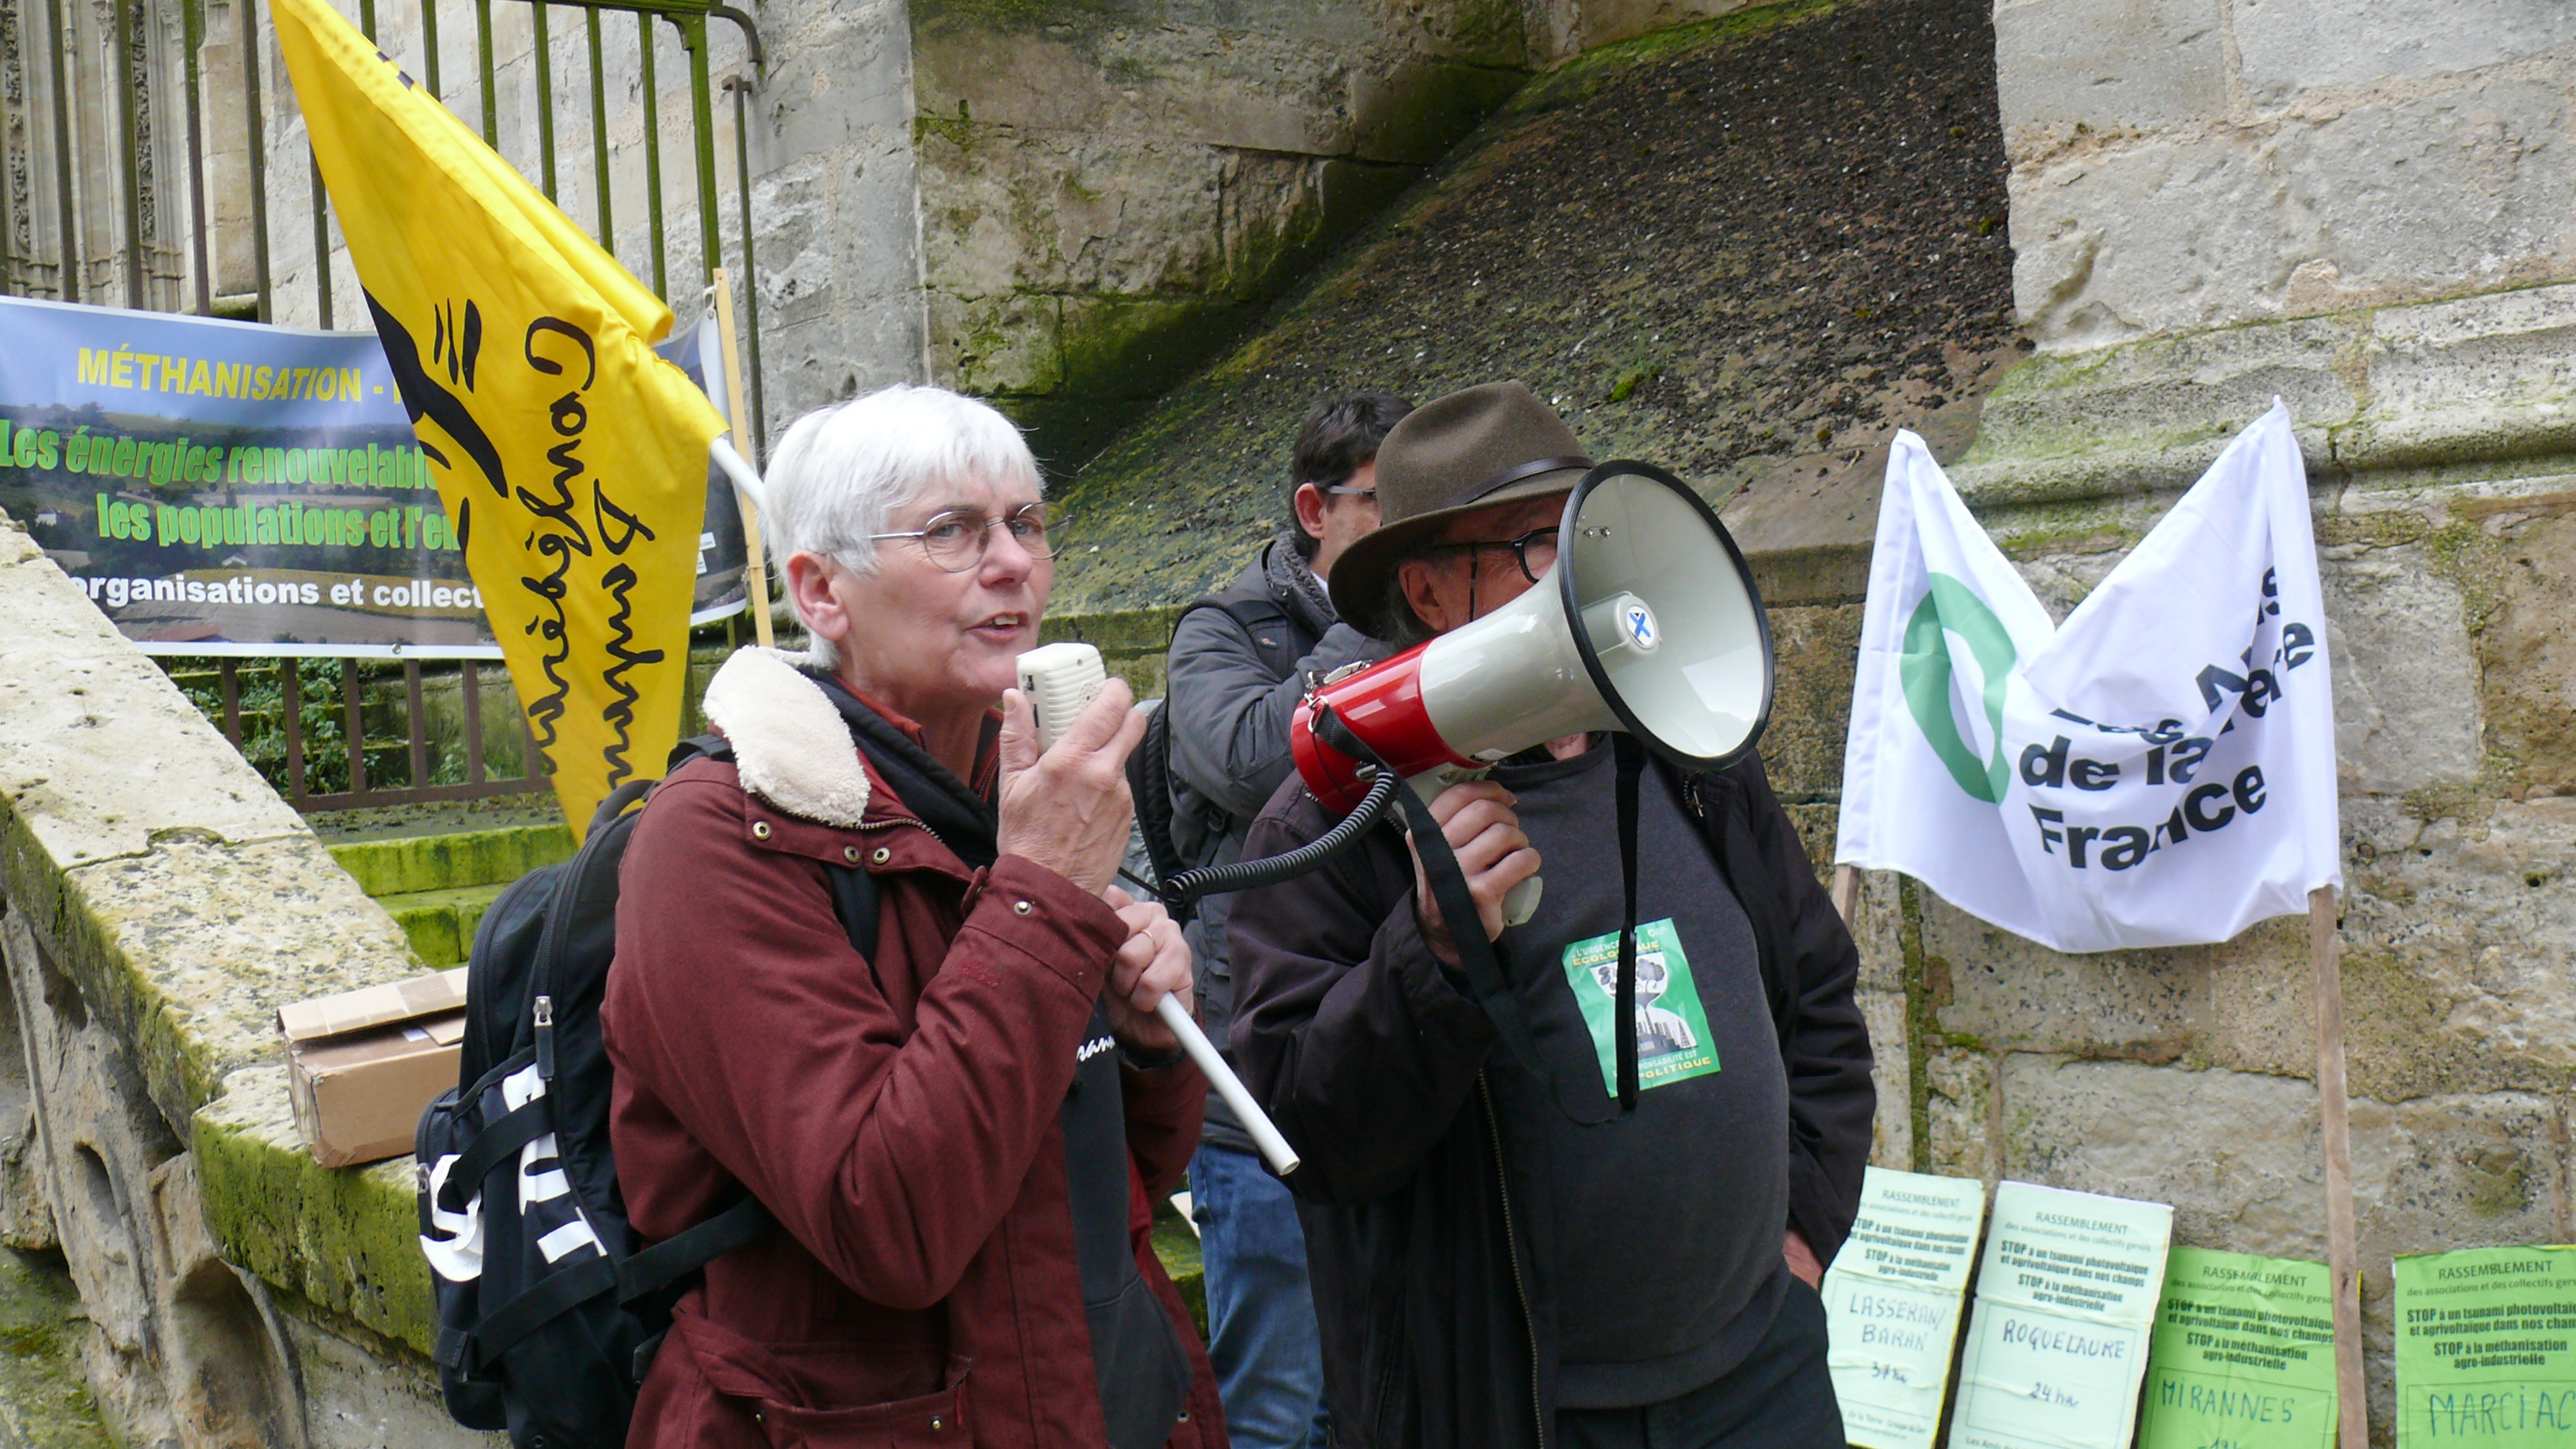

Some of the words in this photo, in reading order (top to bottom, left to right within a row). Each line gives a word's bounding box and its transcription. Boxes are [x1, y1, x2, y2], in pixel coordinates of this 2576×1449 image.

[77, 343, 361, 402] MÉTHANISATION
[0, 419, 59, 470] Les
[65, 425, 224, 486] énergies
[97, 492, 152, 541] les
[156, 501, 364, 549] populations
[370, 507, 400, 551] et
[331, 576, 364, 608] et
[2019, 735, 2120, 791] de
[2028, 765, 2267, 871] France
[1882, 1190, 1961, 1208] RASSEMBLEMENT
[2020, 1224, 2067, 1240] associations
[2036, 1211, 2128, 1235] RASSEMBLEMENT
[1864, 1248, 1888, 1261] STOP
[2001, 1239, 2028, 1254] STOP
[2036, 1248, 2048, 1259] un
[2048, 1250, 2085, 1265] tsunami
[2000, 1254, 2010, 1264] et
[2072, 1266, 2094, 1280] dans
[2094, 1271, 2111, 1283] nos
[2112, 1272, 2145, 1288] champs
[2202, 1266, 2308, 1287] RASSEMBLEMENT
[2439, 1260, 2553, 1281] RASSEMBLEMENT
[2018, 1273, 2044, 1289] STOP
[2051, 1280, 2060, 1292] la
[2407, 1287, 2423, 1297] des
[2424, 1282, 2479, 1296] associations
[2480, 1282, 2490, 1291] et
[2491, 1281, 2507, 1289] des
[2508, 1277, 2553, 1288] collectifs
[2032, 1290, 2106, 1312] agro-industrielle
[2168, 1297, 2194, 1312] STOP
[2203, 1304, 2217, 1315] un
[2218, 1305, 2256, 1320] tsunami
[2407, 1308, 2437, 1322] STOP
[2447, 1309, 2461, 1320] un
[2462, 1304, 2505, 1320] tsunami
[2002, 1318, 2127, 1359] ROQUELAURE
[2168, 1312, 2178, 1323] et
[2241, 1321, 2268, 1335] dans
[2269, 1325, 2290, 1338] nos
[2291, 1328, 2334, 1344] champs
[2409, 1325, 2421, 1336] et
[2493, 1319, 2519, 1331] dans
[2521, 1319, 2544, 1330] nos
[2186, 1332, 2214, 1348] STOP
[2222, 1338, 2230, 1350] la
[2230, 1340, 2309, 1361] méthanisation
[2434, 1341, 2464, 1356] STOP
[2473, 1341, 2483, 1354] la
[2484, 1339, 2568, 1353] méthanisation
[2202, 1349, 2287, 1371] agro-industrielle
[2454, 1353, 2546, 1370] agro-industrielle
